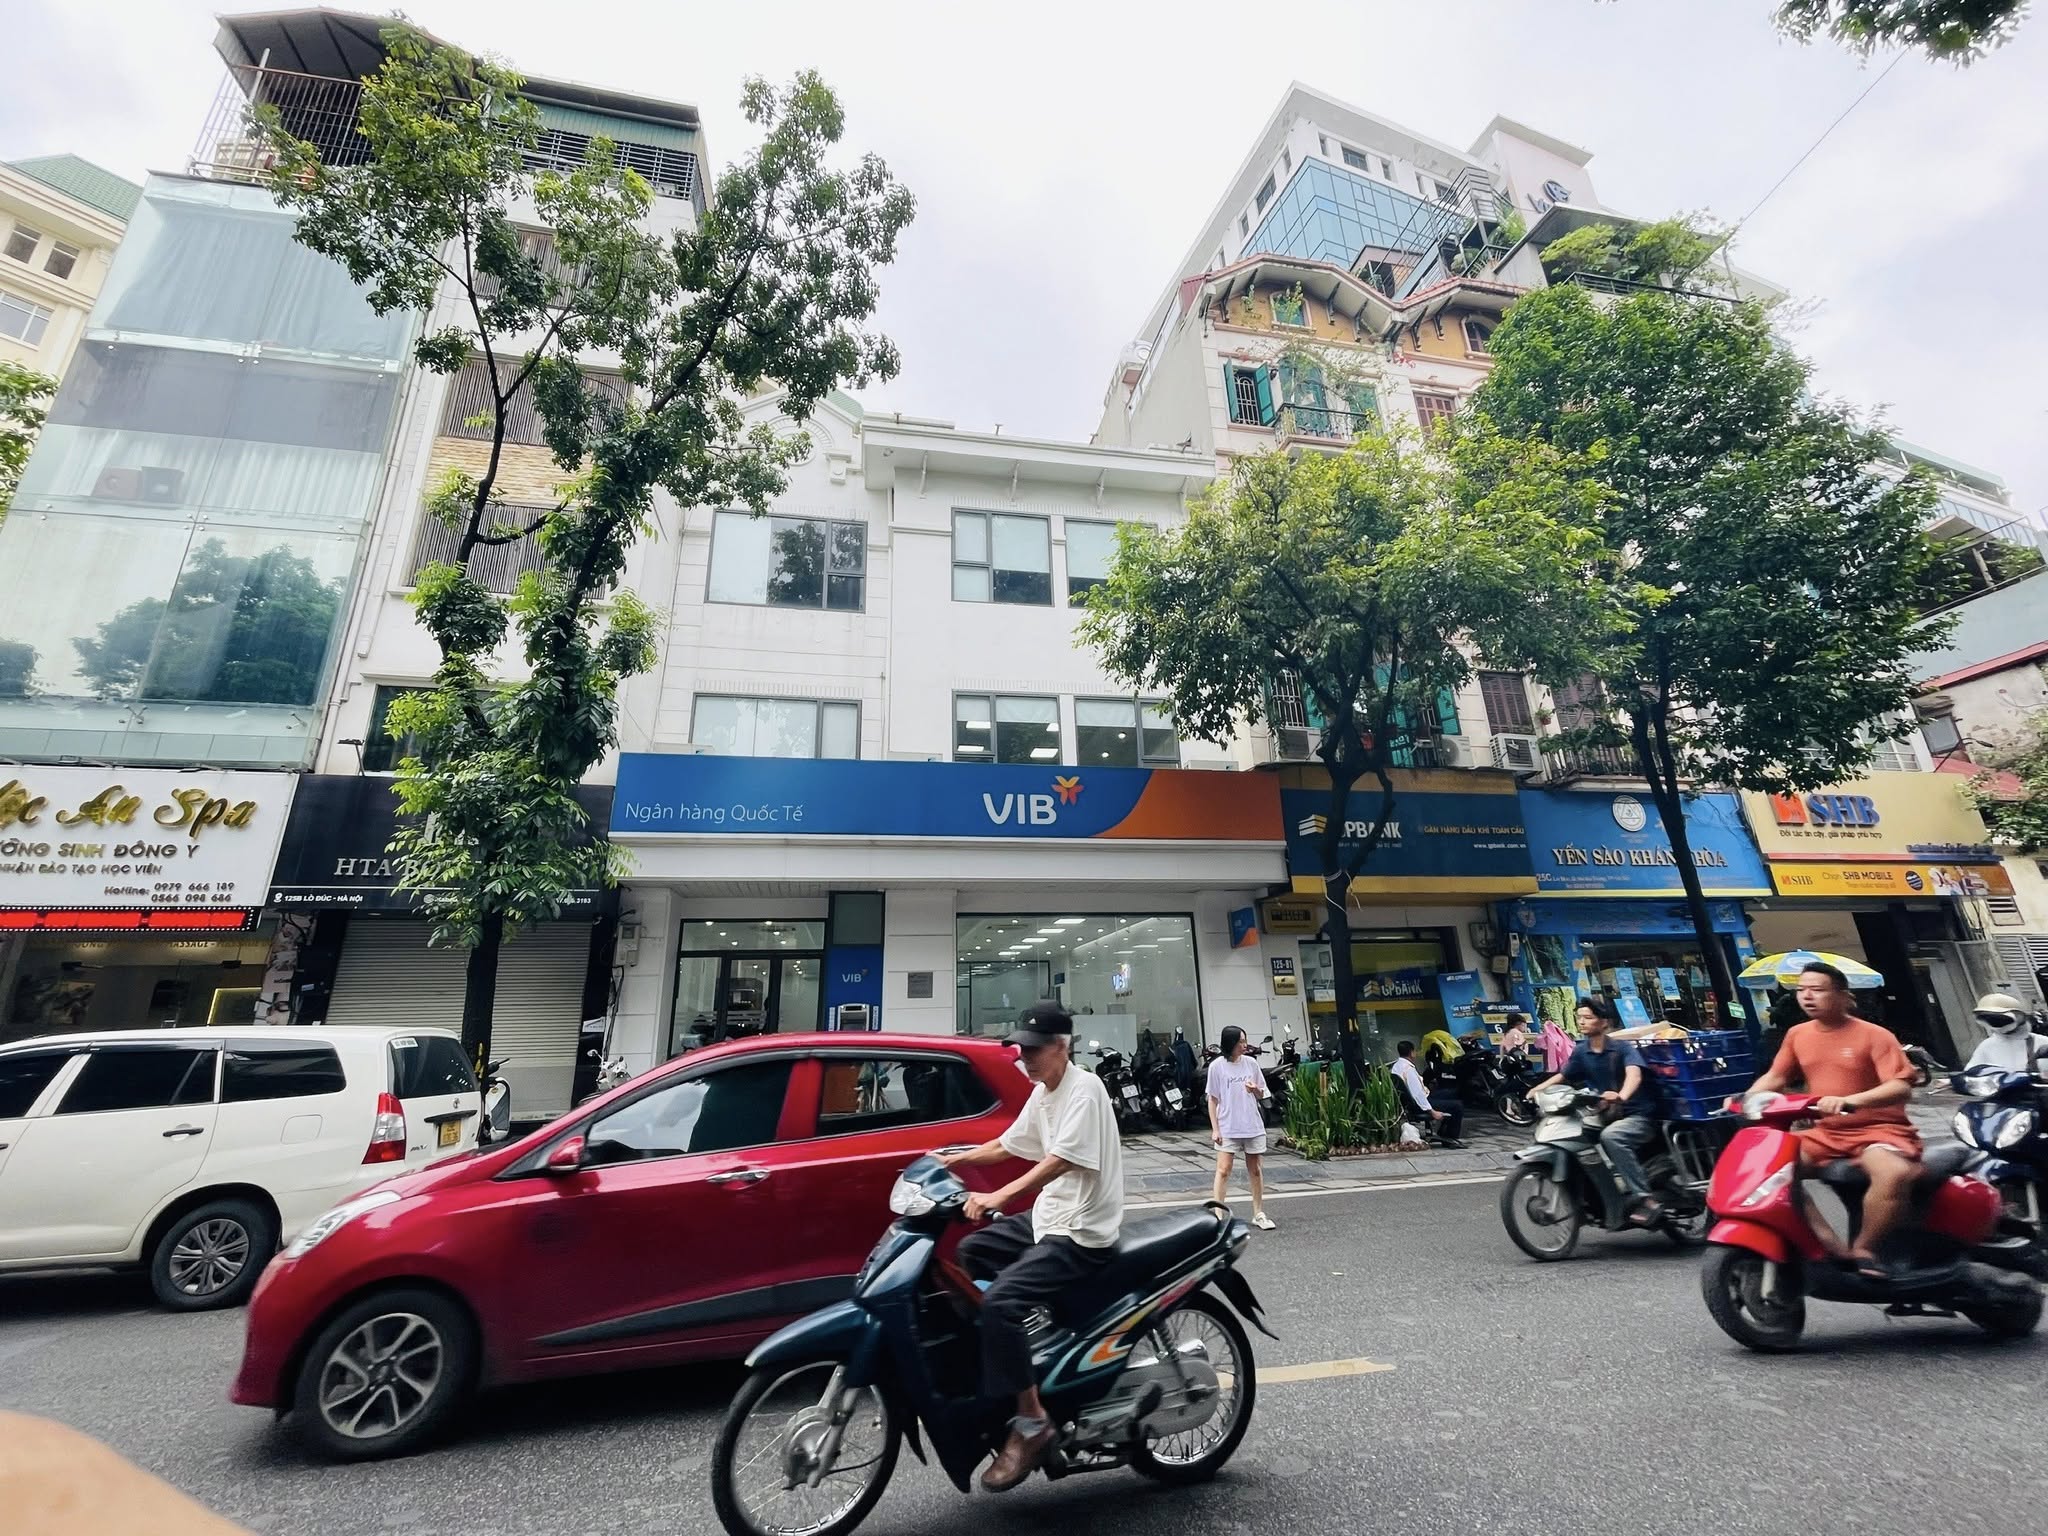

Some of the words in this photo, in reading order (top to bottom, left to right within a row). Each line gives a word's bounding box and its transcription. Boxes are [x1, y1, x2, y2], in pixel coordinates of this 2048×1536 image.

[56, 785, 141, 826] An
[154, 788, 257, 839] Spa
[625, 803, 674, 823] Ngân
[679, 804, 726, 824] hàng
[731, 803, 779, 822] Quốc
[783, 804, 803, 822] Tế
[983, 793, 1057, 825] VIB
[1806, 793, 1880, 825] SHB
[58, 842, 105, 858] SINH
[114, 840, 178, 859] ĐÔNG
[187, 844, 200, 858] Y
[1552, 842, 1588, 865] YẾN
[1592, 844, 1626, 866] SÀO
[1628, 845, 1678, 867] KHÁN
[1691, 847, 1728, 868] HÒA
[72, 864, 97, 876] TẠO
[101, 864, 131, 877] HỌC
[135, 862, 162, 876] VIÊN
[334, 858, 393, 877] HTA
[1842, 871, 1860, 880] SHB
[1861, 872, 1894, 881] MOBILE
[104, 885, 150, 896] Hotline:
[154, 882, 182, 892] 0979
[188, 882, 210, 892] 666
[216, 881, 235, 891] 189
[1791, 875, 1814, 885] SHB
[337, 894, 349, 902] HÀ
[349, 894, 364, 903] NỘI
[842, 973, 862, 983] VIB
